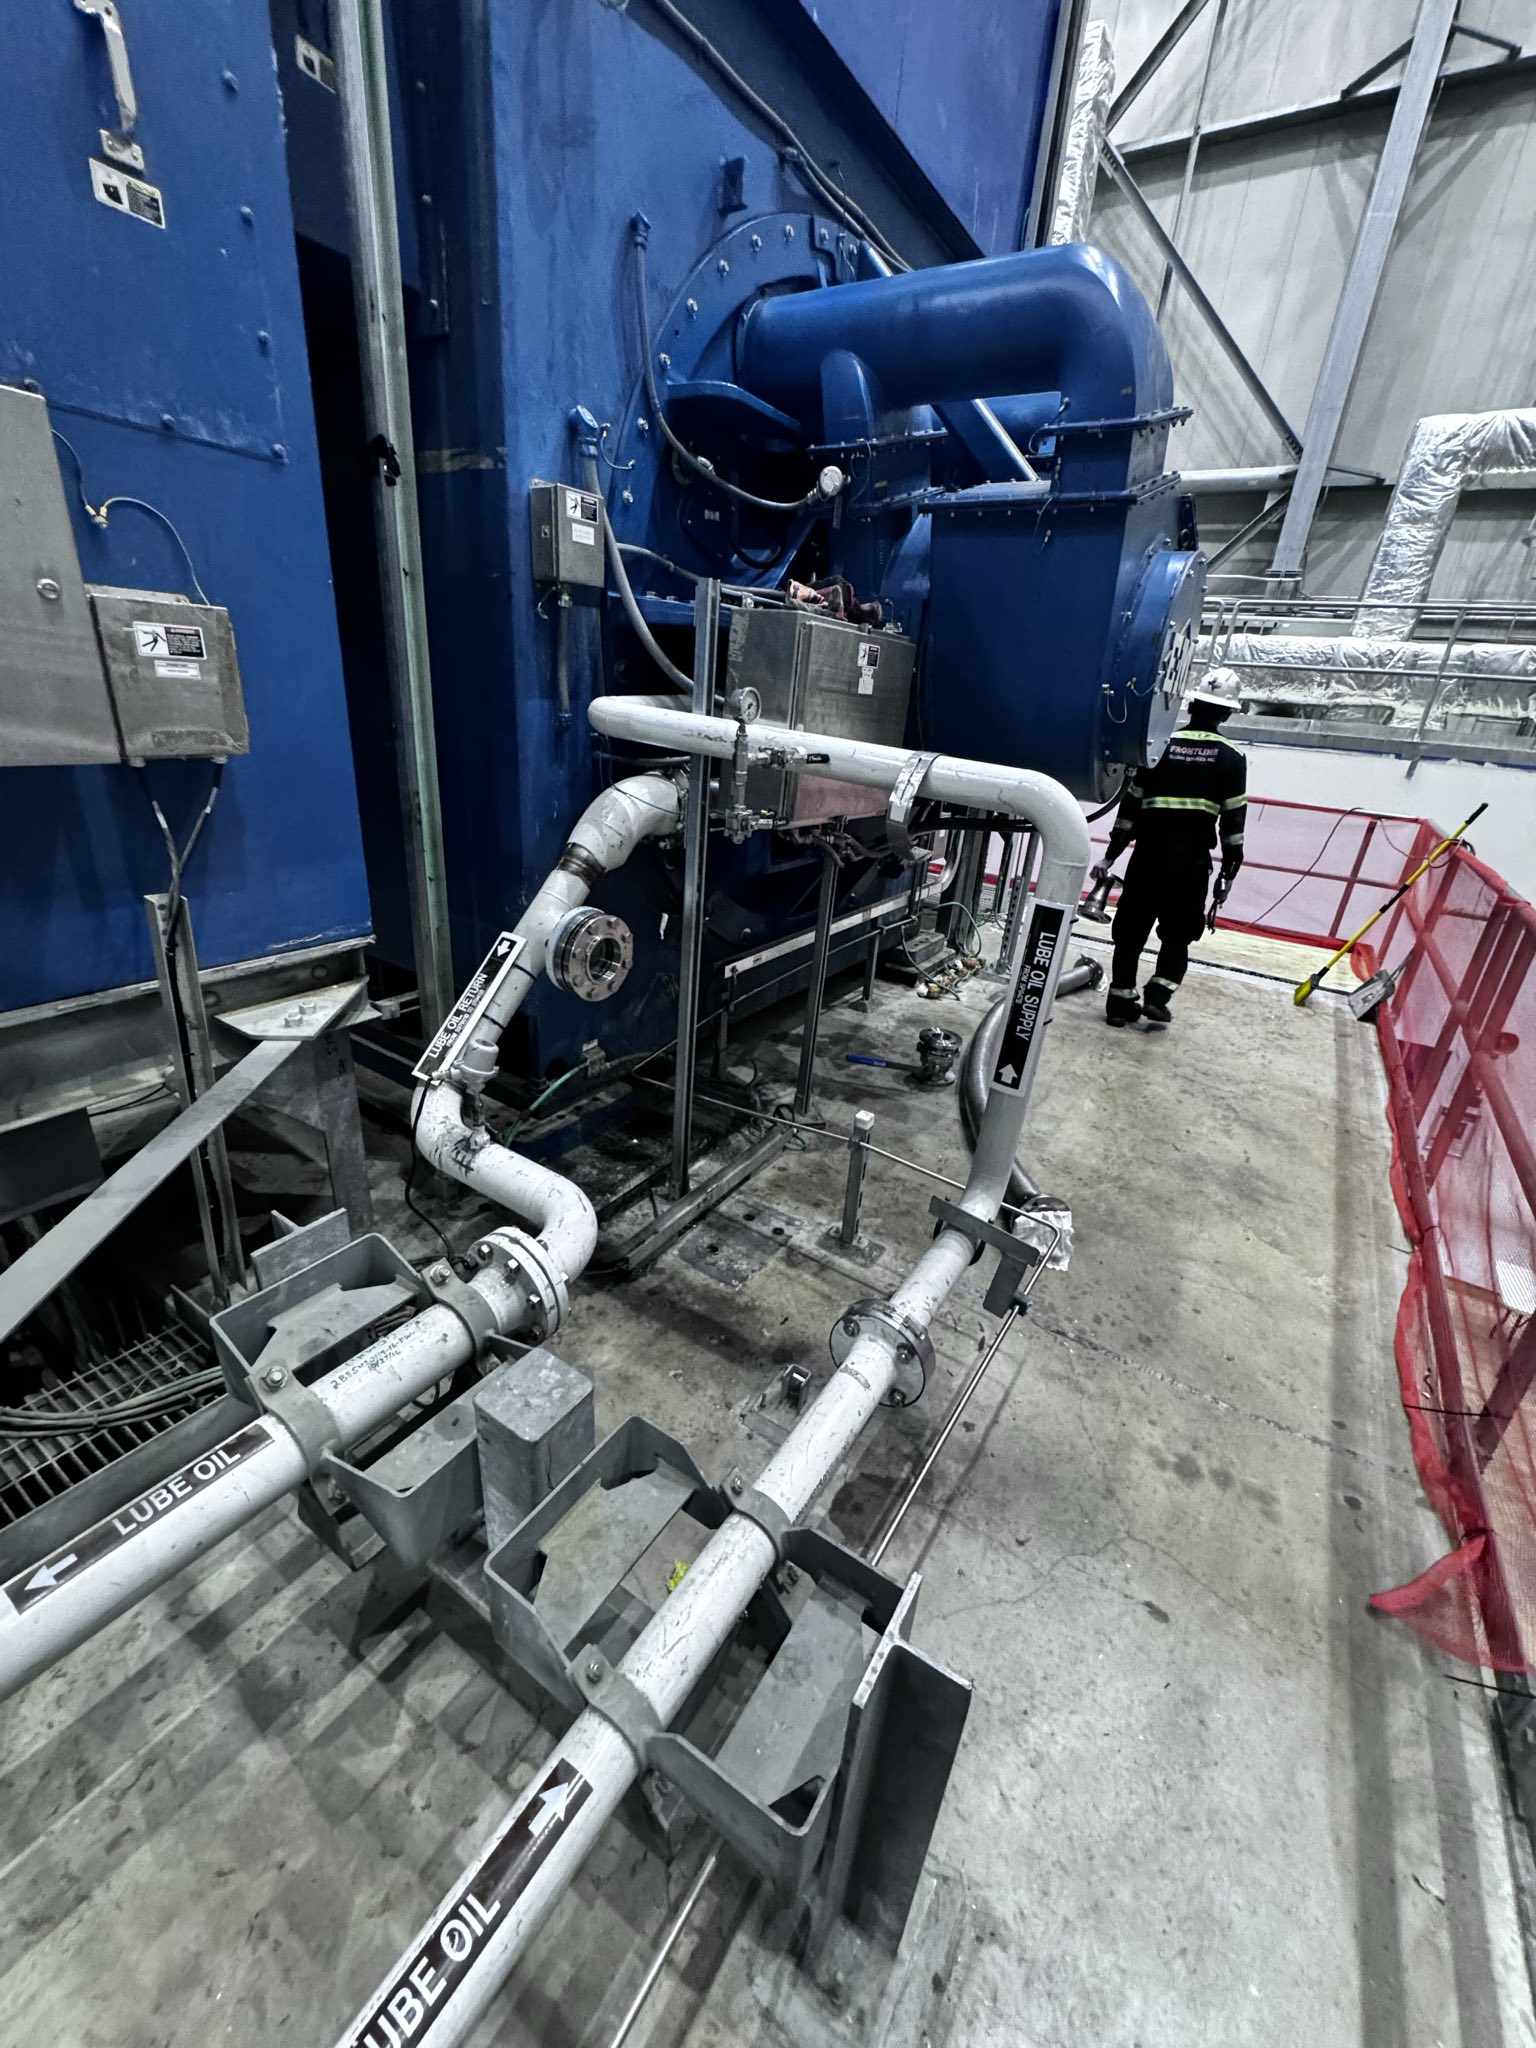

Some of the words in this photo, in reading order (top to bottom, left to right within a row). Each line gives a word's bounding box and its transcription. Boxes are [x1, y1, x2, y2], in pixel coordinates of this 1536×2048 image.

[1170, 745, 1219, 756] FRONTLINE
[1033, 932, 1056, 967] LUBE
[1022, 965, 1031, 982] FROM
[1027, 970, 1045, 989] OIL
[429, 1030, 450, 1058] LUBE
[447, 1014, 463, 1029] OIL
[459, 973, 488, 1011] RETURN
[1016, 994, 1040, 1041] SUPPLY
[112, 1477, 193, 1536] LUBE
[193, 1449, 242, 1480] OIL
[353, 1956, 447, 2048] UBE
[440, 1893, 501, 1962] OIL
